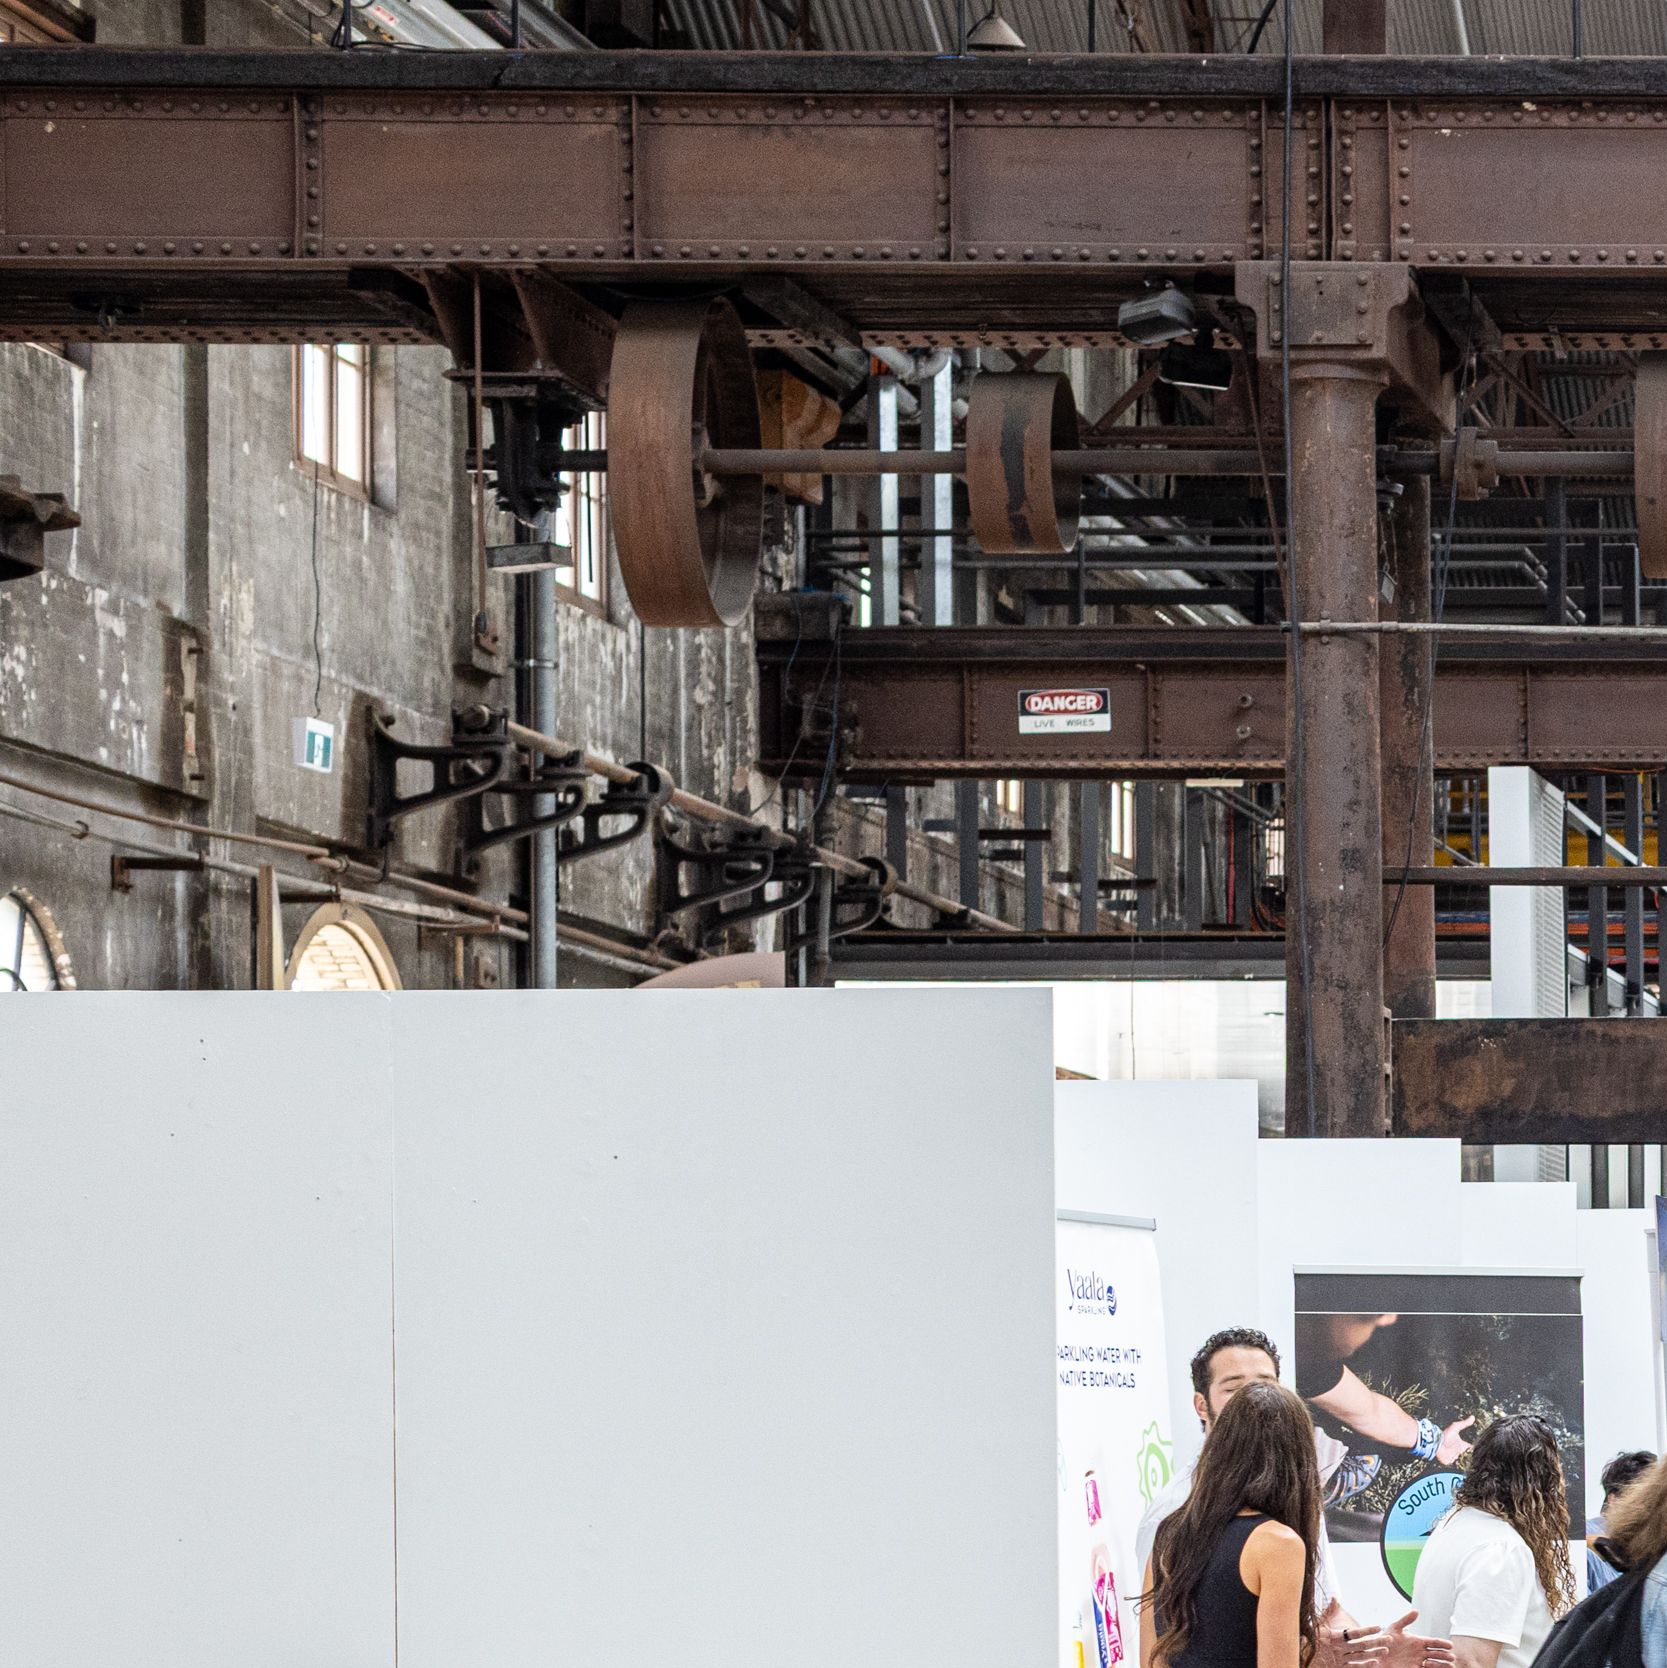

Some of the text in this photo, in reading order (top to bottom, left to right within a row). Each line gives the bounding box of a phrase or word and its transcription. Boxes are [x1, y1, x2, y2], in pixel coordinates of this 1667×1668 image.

[1029, 695, 1098, 712] DANGER
[1034, 717, 1096, 729] LIVE WIRES
[1096, 1348, 1121, 1363] WATER
[1122, 1349, 1142, 1364] WITH
[1059, 1370, 1137, 1388] NATIVE BOTANICALS
[1397, 1477, 1446, 1516] South
